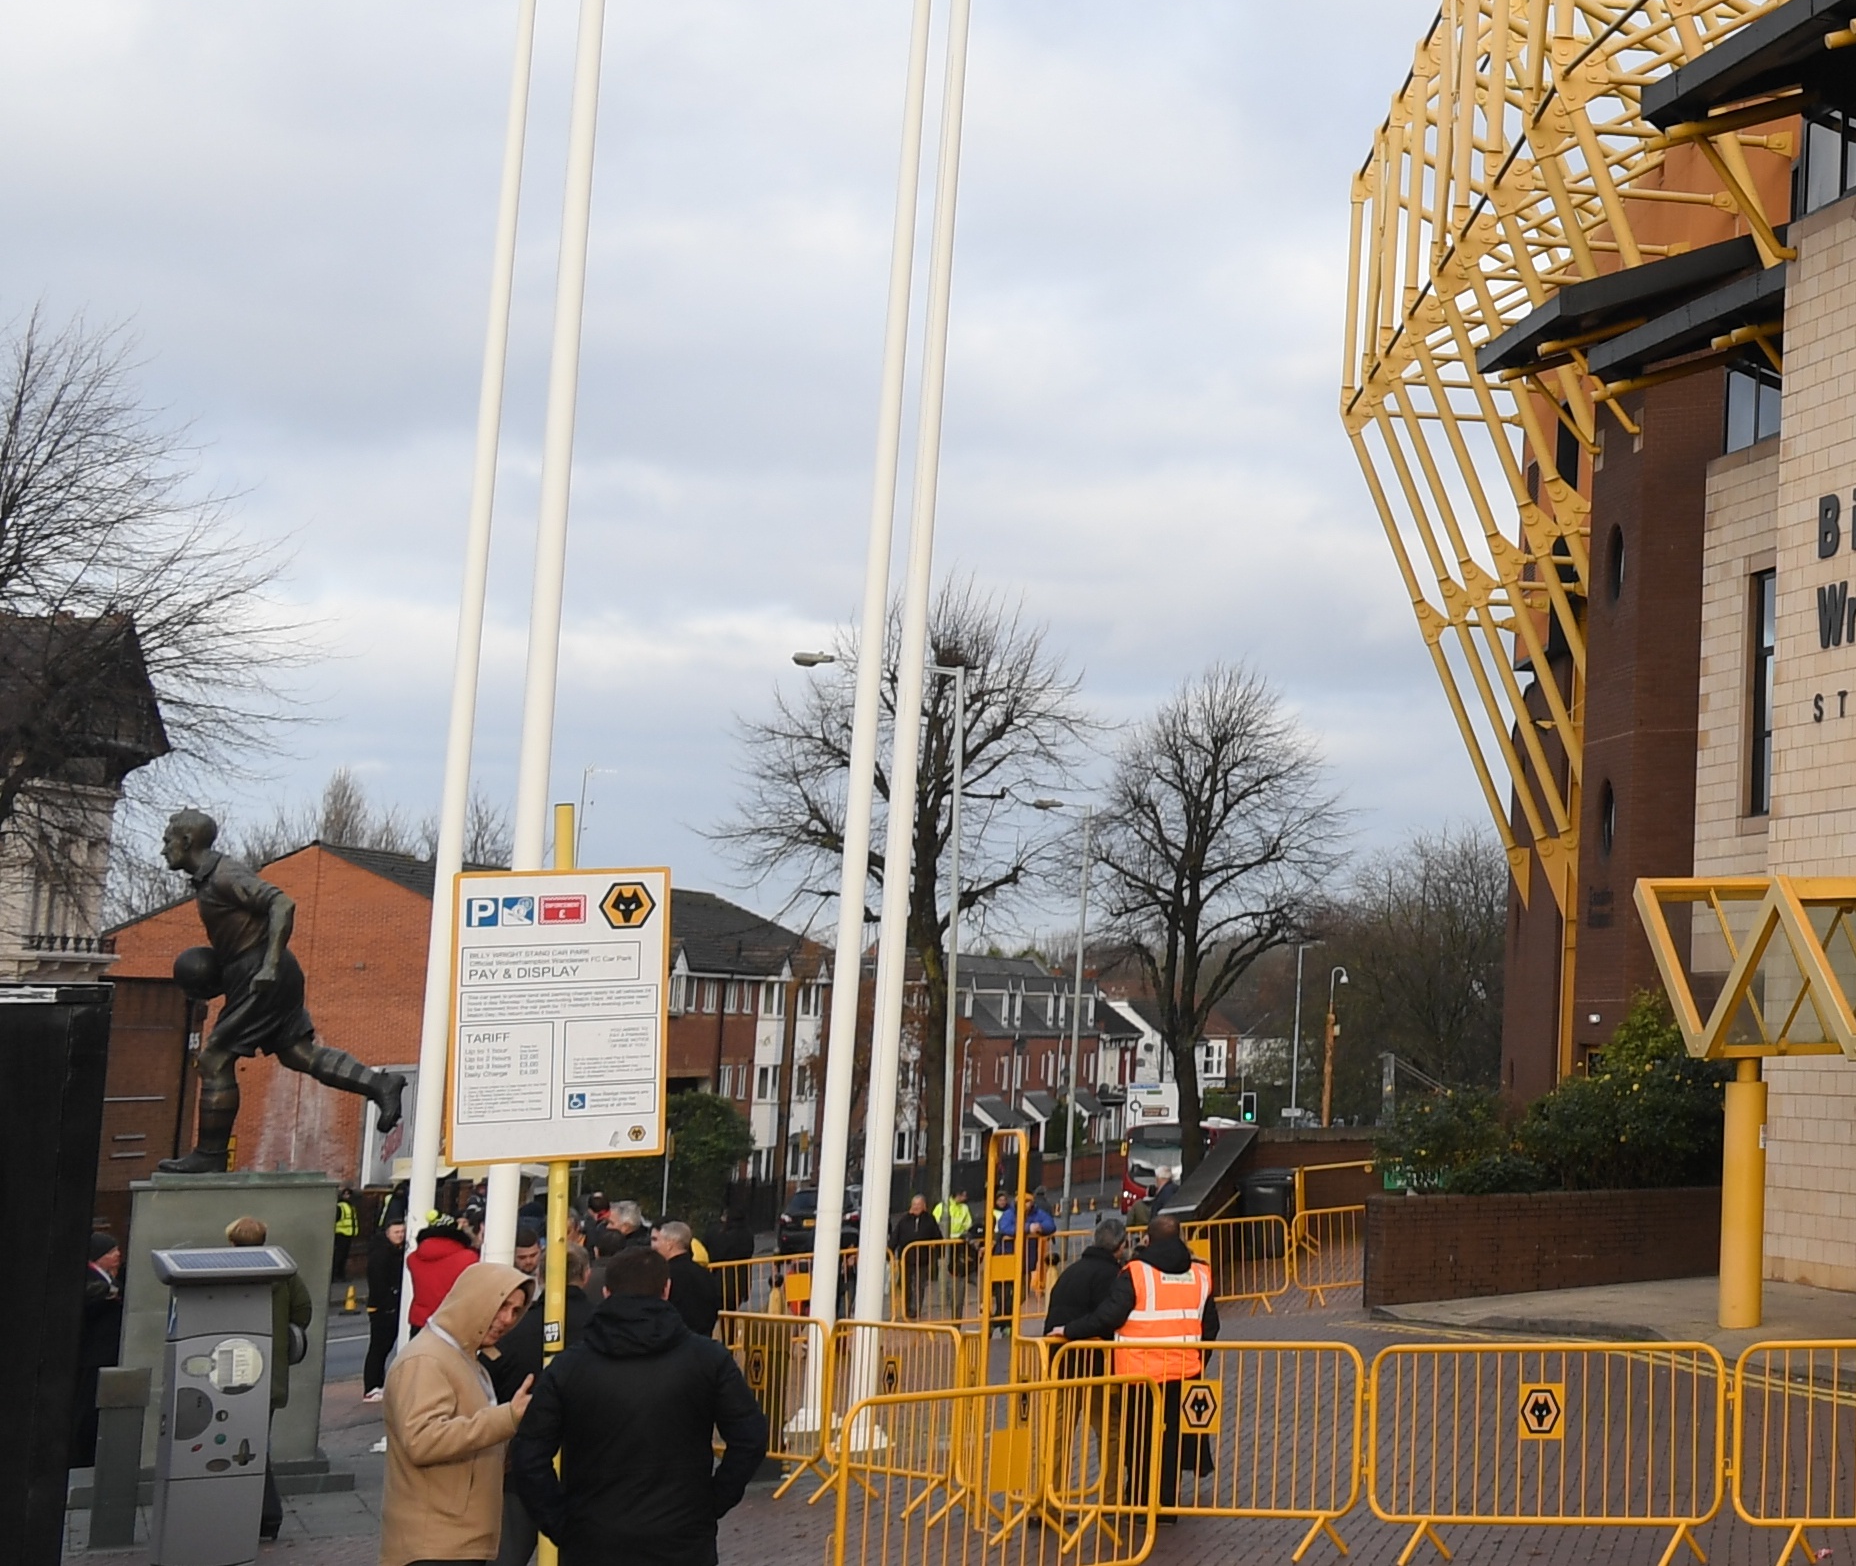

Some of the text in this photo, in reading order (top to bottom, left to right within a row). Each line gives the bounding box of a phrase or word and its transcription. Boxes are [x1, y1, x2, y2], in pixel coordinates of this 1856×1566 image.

[471, 899, 495, 927] P
[468, 965, 580, 981] PAY & DISPLAY
[465, 1031, 511, 1044] TARIFF
